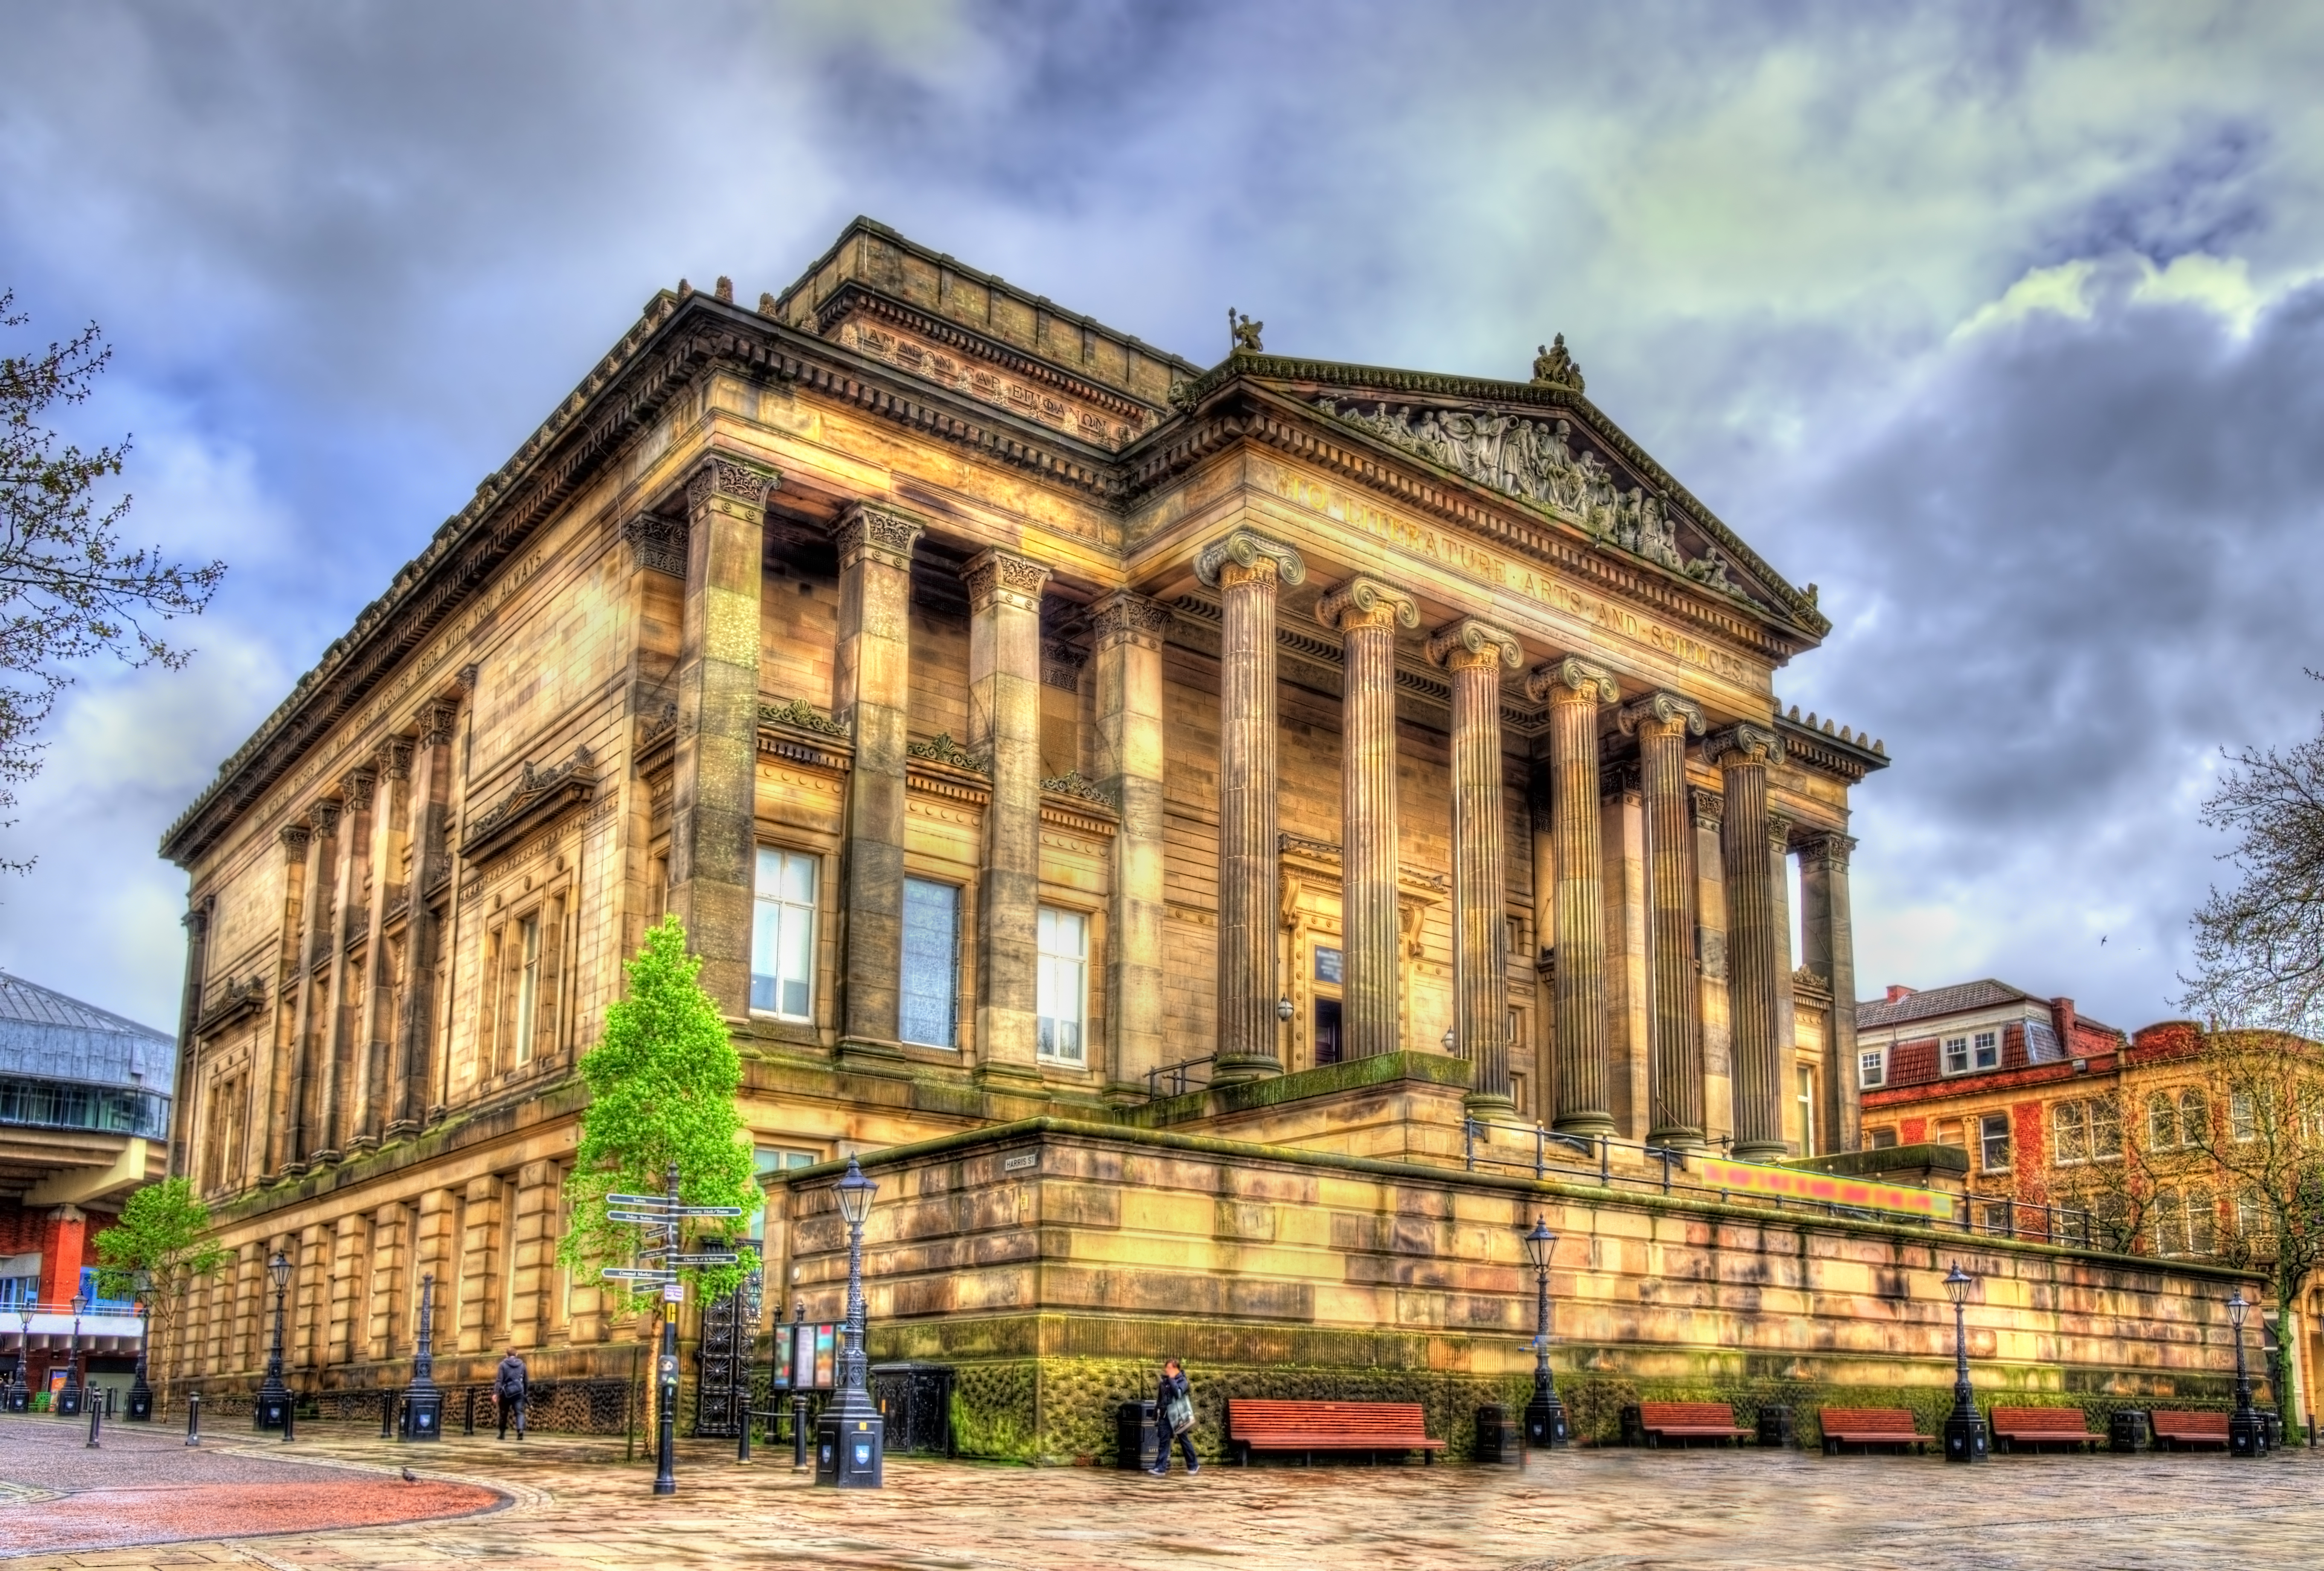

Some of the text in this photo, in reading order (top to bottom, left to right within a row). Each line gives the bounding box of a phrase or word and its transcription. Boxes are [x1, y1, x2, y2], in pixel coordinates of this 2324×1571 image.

[1288, 473, 1326, 510] TO
[1345, 497, 1506, 584] LITERATURE
[1524, 573, 1582, 614] ARTS
[1596, 604, 1637, 636] AND
[1651, 625, 1743, 682] SCIENCES
[1007, 1158, 1026, 1168] HARRIS
